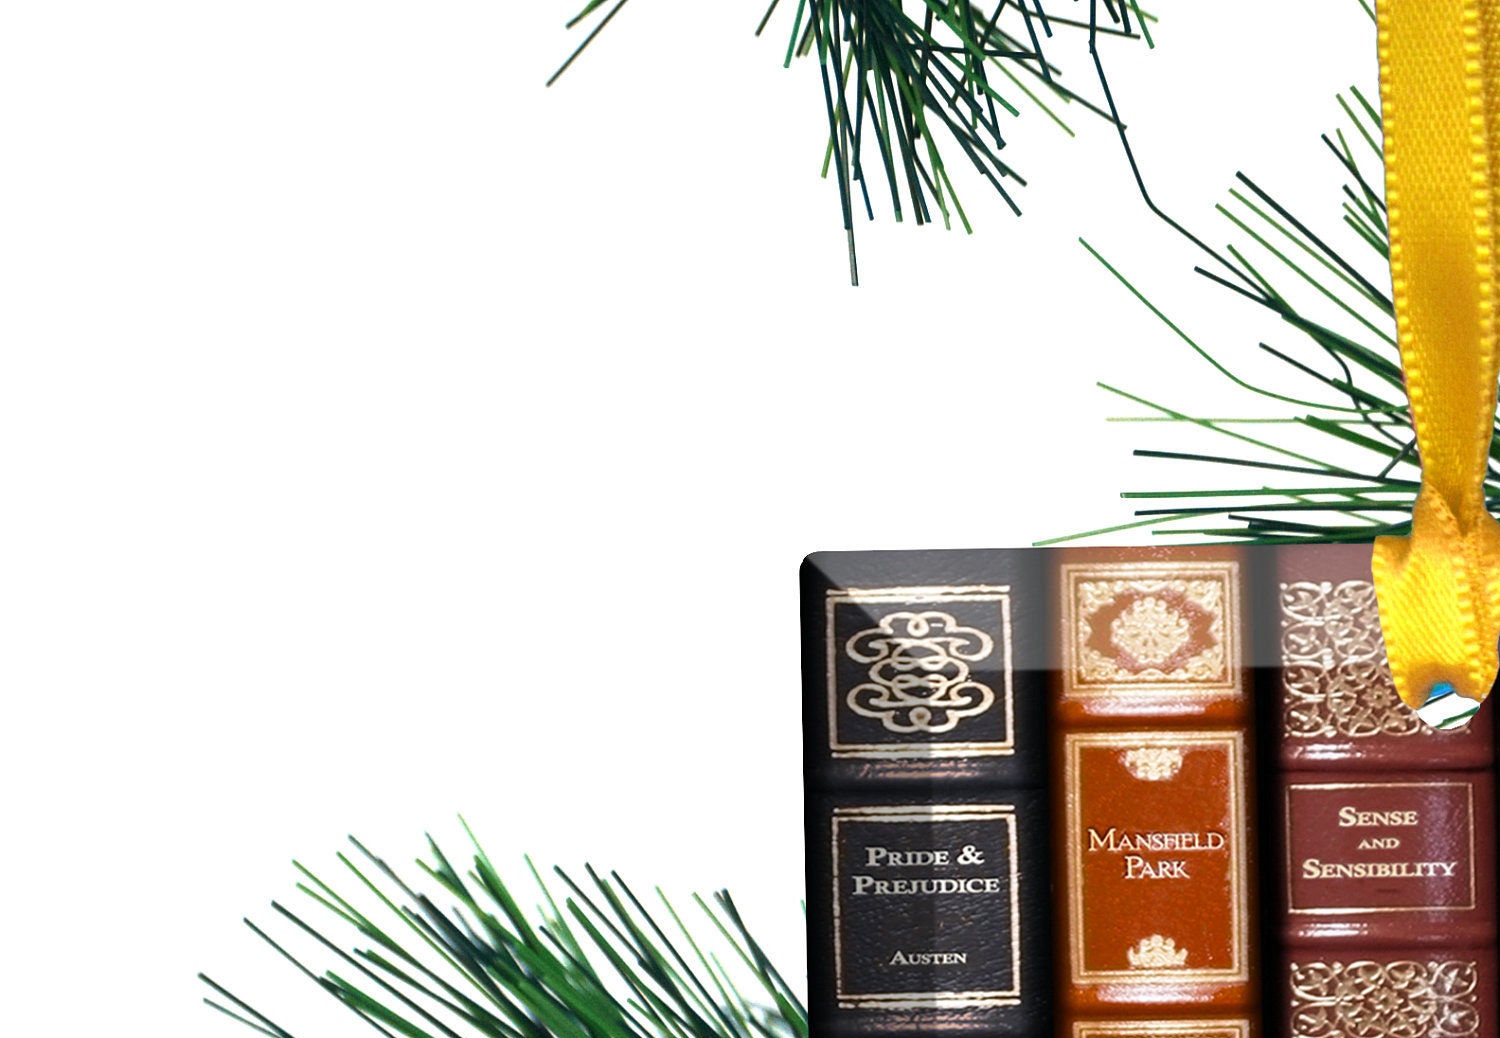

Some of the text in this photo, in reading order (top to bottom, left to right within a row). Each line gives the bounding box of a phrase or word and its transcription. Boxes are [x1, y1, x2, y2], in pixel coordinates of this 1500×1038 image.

[1338, 806, 1418, 827] SENSE
[1088, 828, 1224, 852] MANSFIELD
[1358, 837, 1400, 850] AND
[865, 844, 985, 868] PRIDE &
[1124, 856, 1190, 880] PARK
[1302, 858, 1458, 880] SENSIBILITY
[852, 875, 1000, 896] PREJUDICE
[889, 949, 967, 966] AUSTEN
